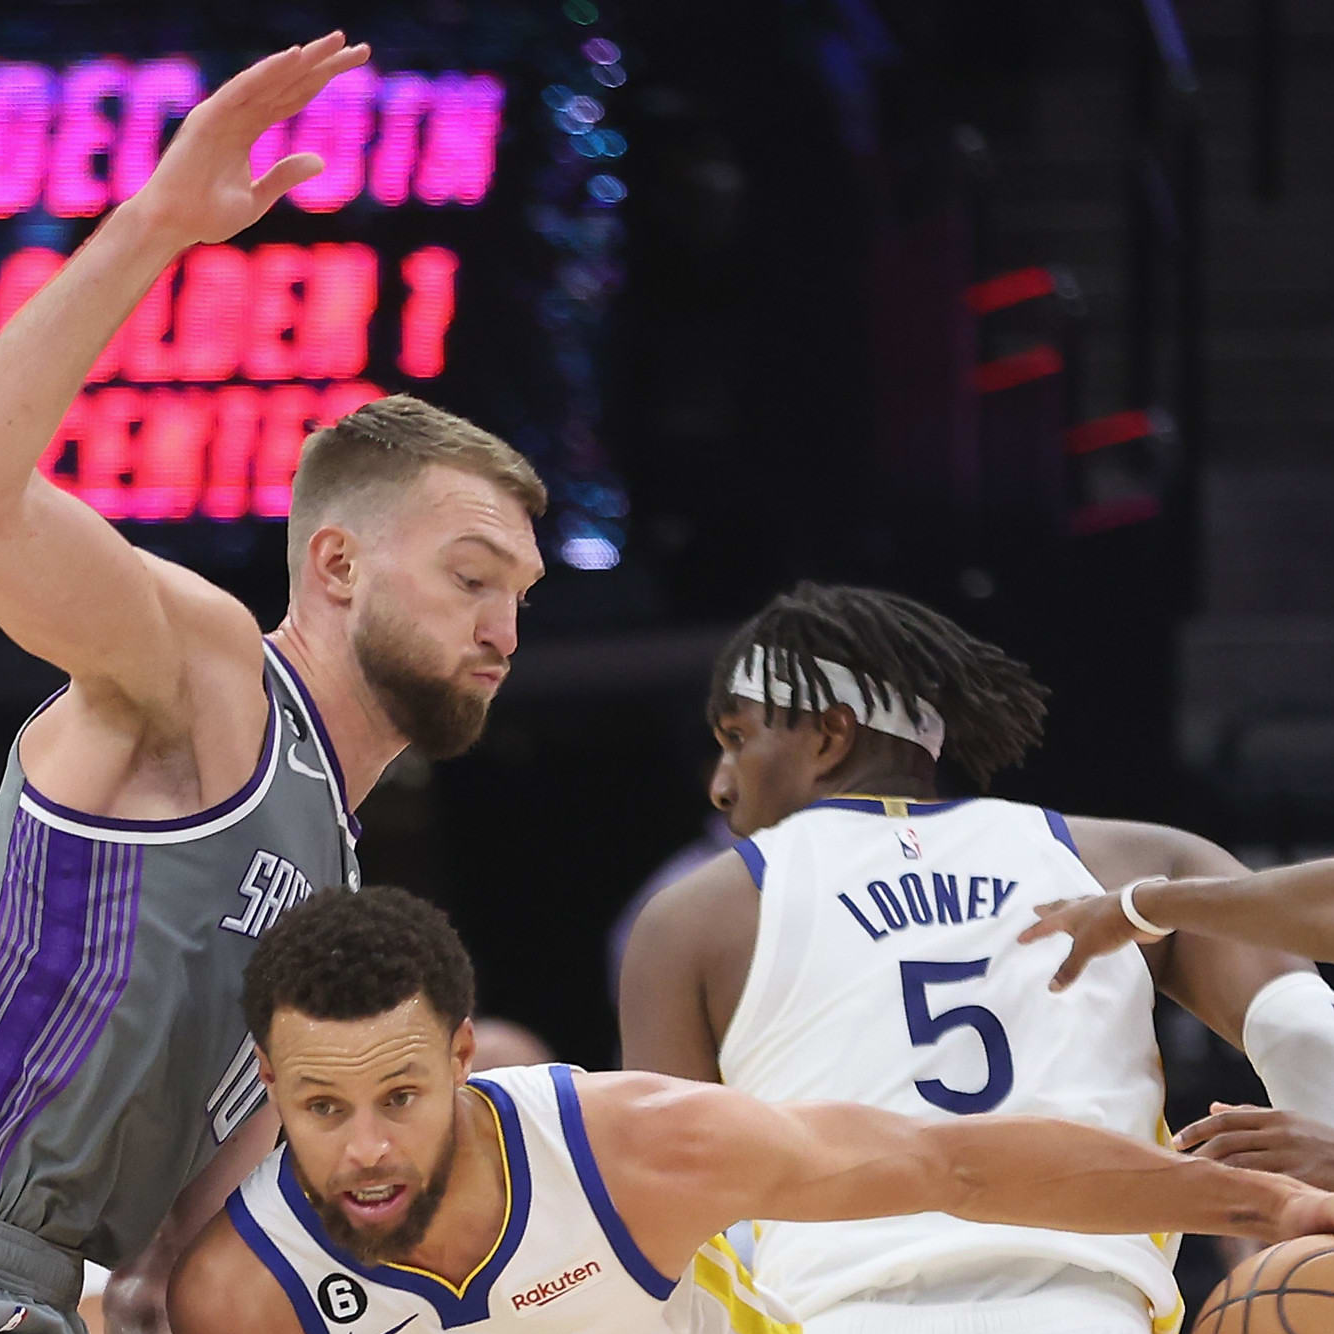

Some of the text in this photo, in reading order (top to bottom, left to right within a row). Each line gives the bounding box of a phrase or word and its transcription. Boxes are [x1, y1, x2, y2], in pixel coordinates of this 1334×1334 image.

[397, 245, 461, 380] 1
[36, 380, 386, 521] ENTE
[219, 849, 314, 939] SAC
[837, 869, 1019, 942] LOONEY
[899, 956, 1015, 1116] 5
[326, 1279, 359, 1319] 6
[511, 1261, 601, 1311] Rakuten
